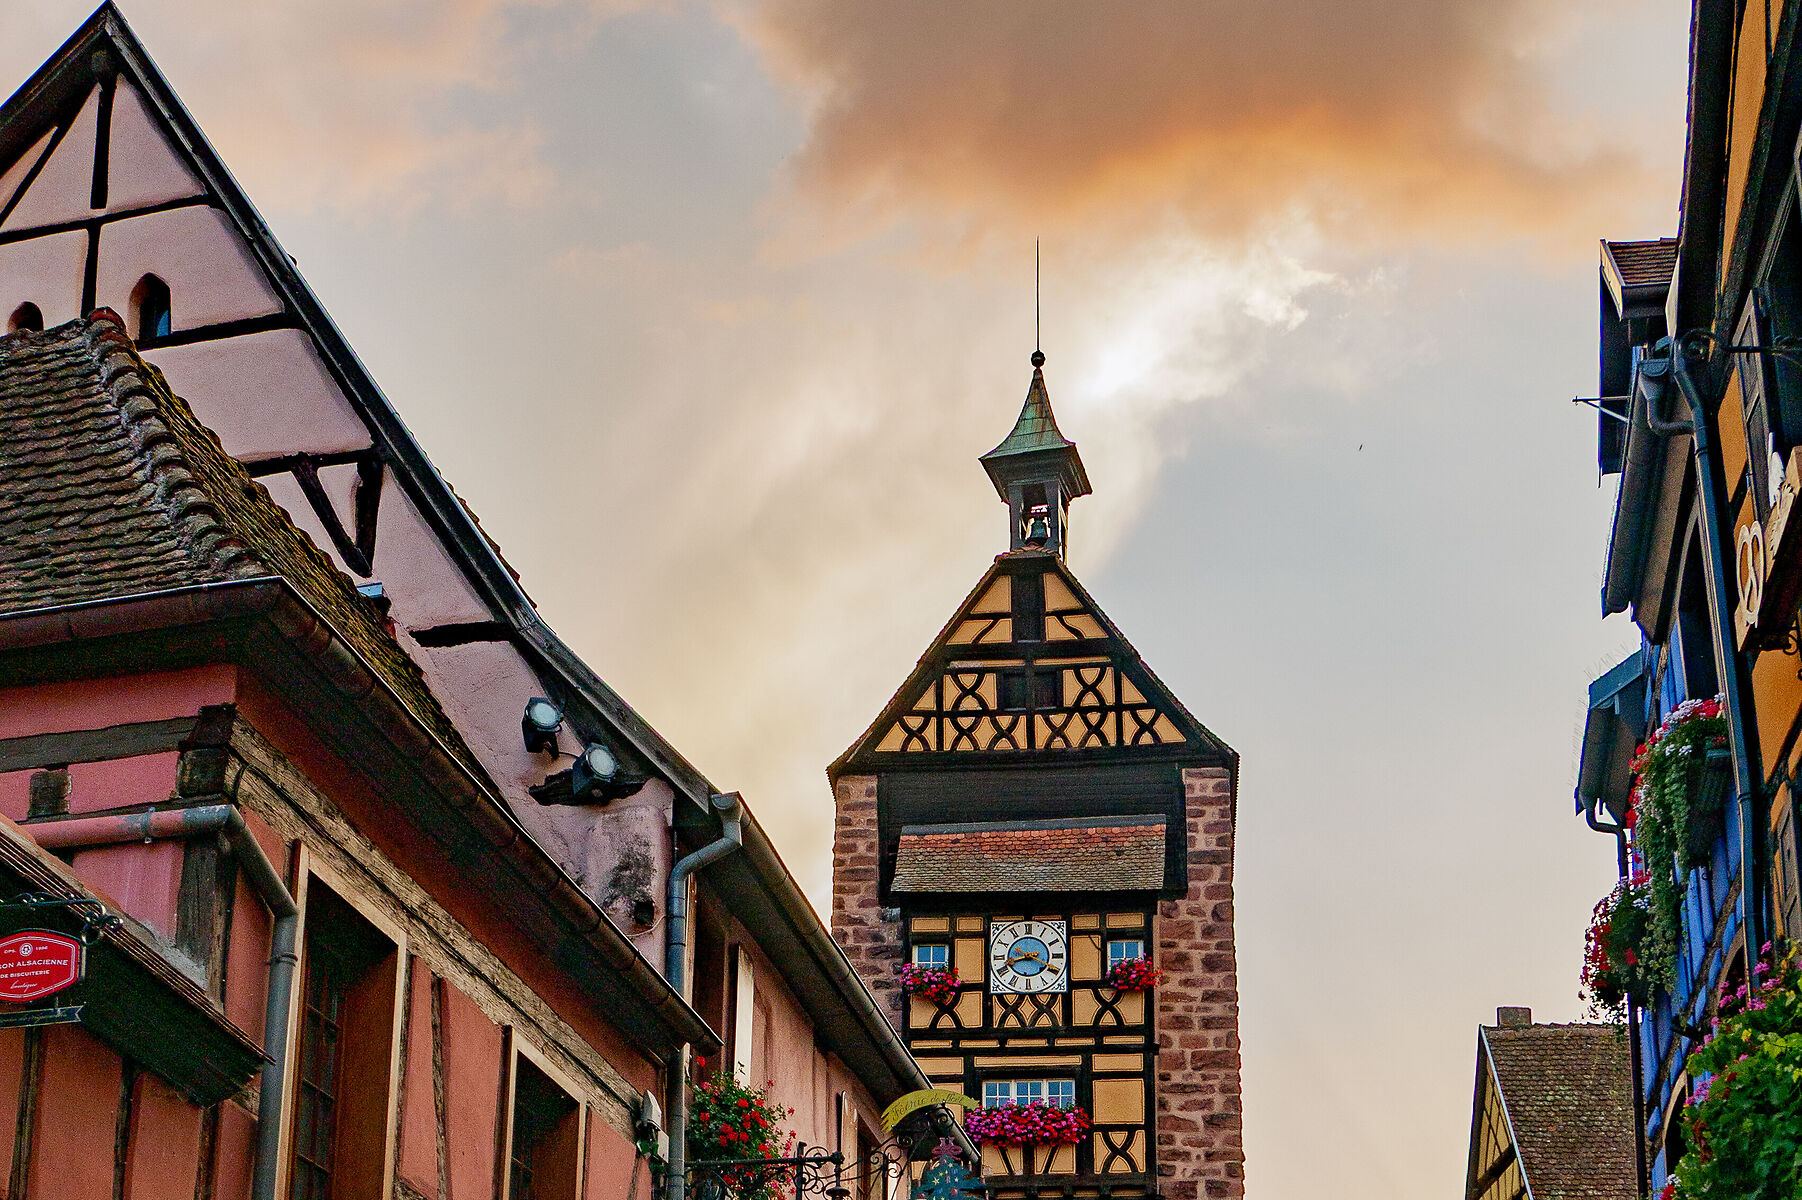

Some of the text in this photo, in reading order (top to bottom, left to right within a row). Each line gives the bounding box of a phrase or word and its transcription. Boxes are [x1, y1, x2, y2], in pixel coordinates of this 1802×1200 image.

[16, 959, 68, 968] ALSACIENNE
[10, 969, 50, 978] BISCUITERIE
[10, 980, 38, 993] boutique
